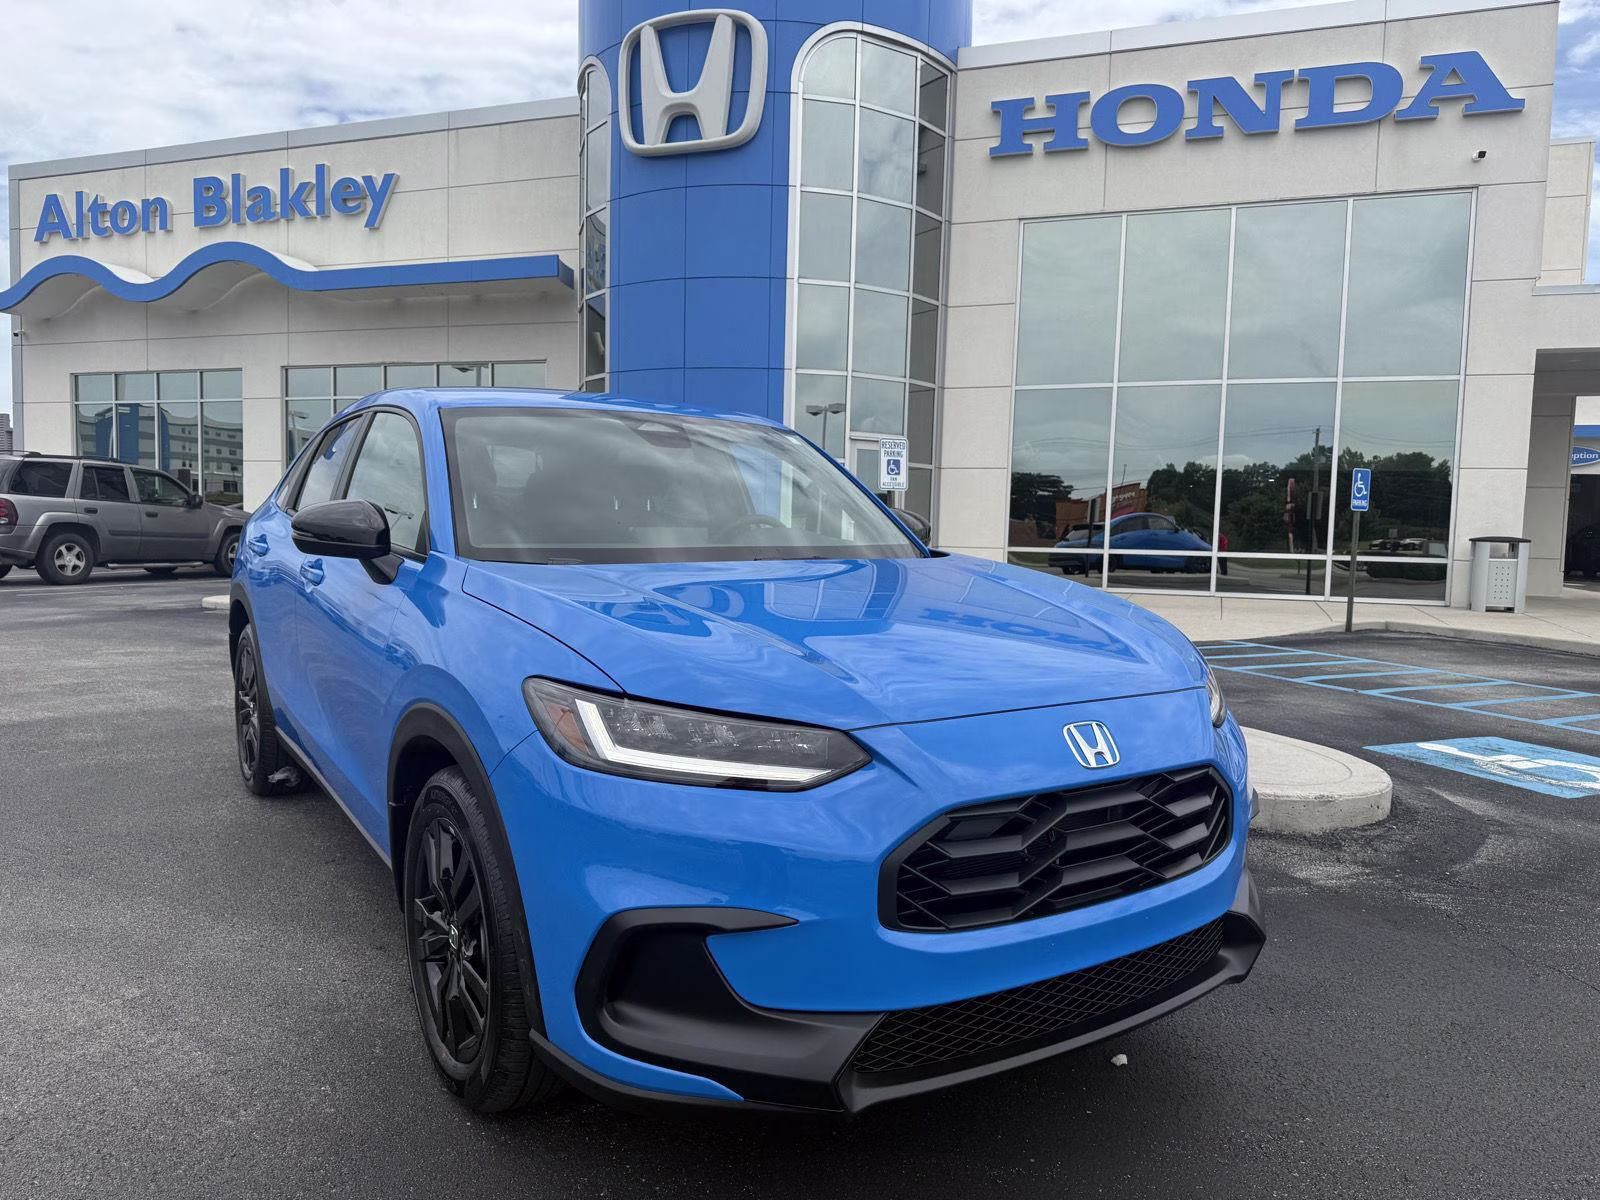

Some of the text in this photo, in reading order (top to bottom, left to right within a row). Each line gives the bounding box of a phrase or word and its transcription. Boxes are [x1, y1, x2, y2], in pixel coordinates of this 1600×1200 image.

[988, 50, 1526, 158] HONDA
[34, 163, 400, 243] Alton Blakley
[881, 440, 905, 449] RESERVED
[883, 449, 903, 458] PARKING
[1571, 452, 1599, 460] ption
